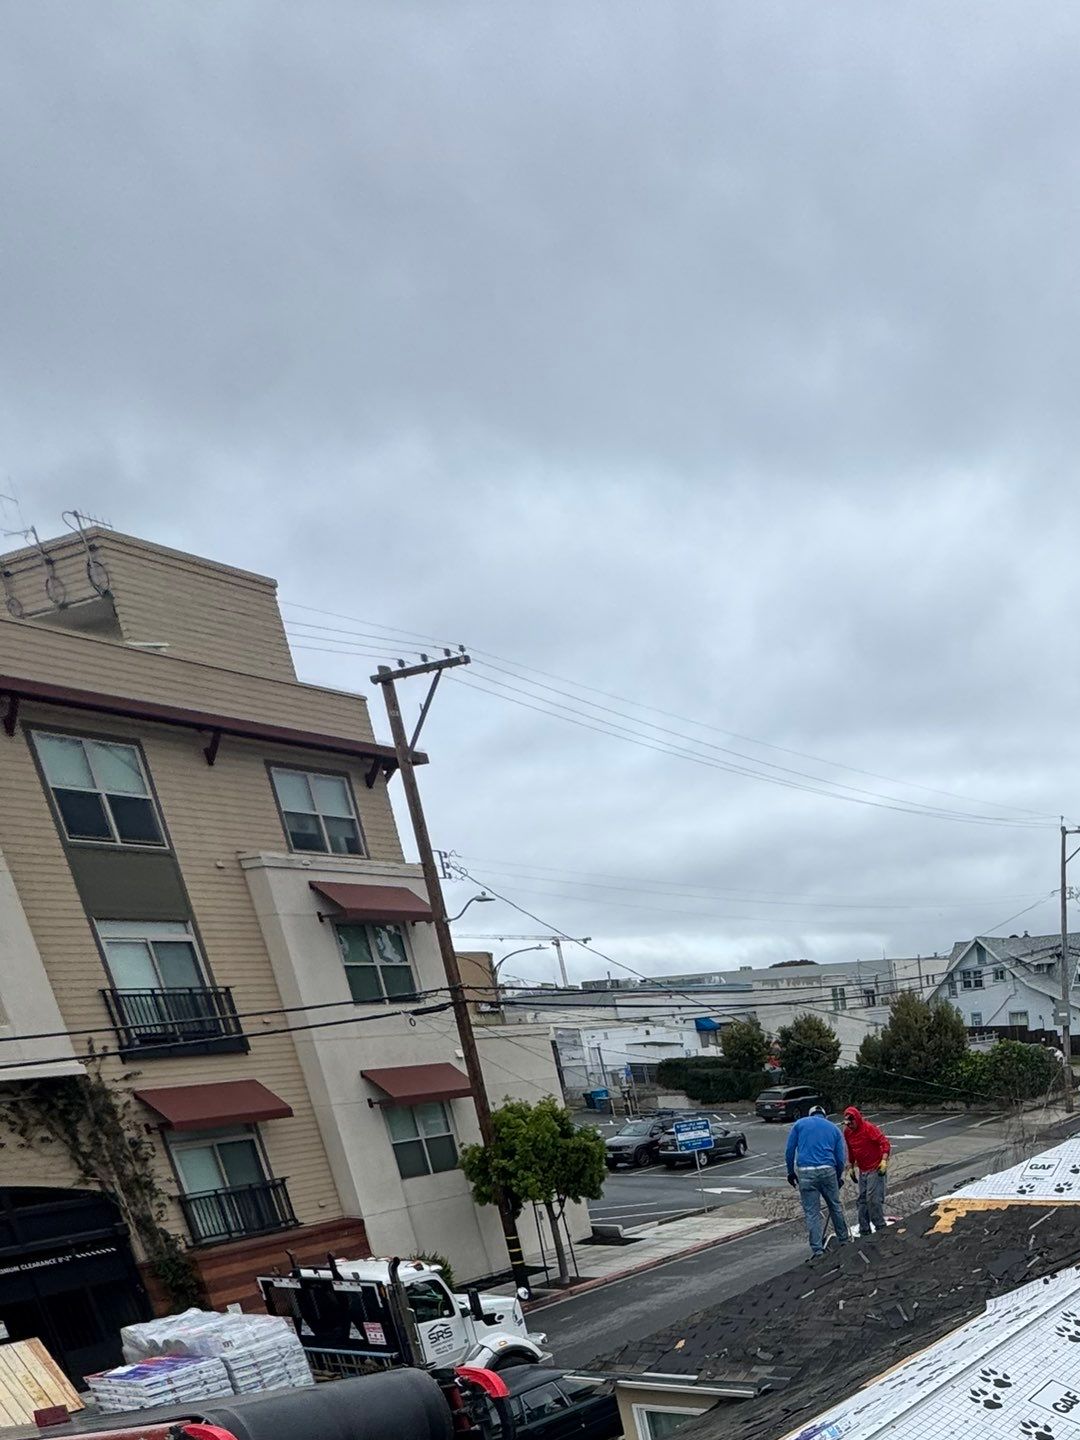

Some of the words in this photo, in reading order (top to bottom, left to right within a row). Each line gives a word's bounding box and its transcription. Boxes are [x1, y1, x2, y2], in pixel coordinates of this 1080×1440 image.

[20, 1258, 57, 1270] CLEARANCE
[428, 1326, 454, 1344] SRS
[1052, 1391, 1080, 1413] GAF
